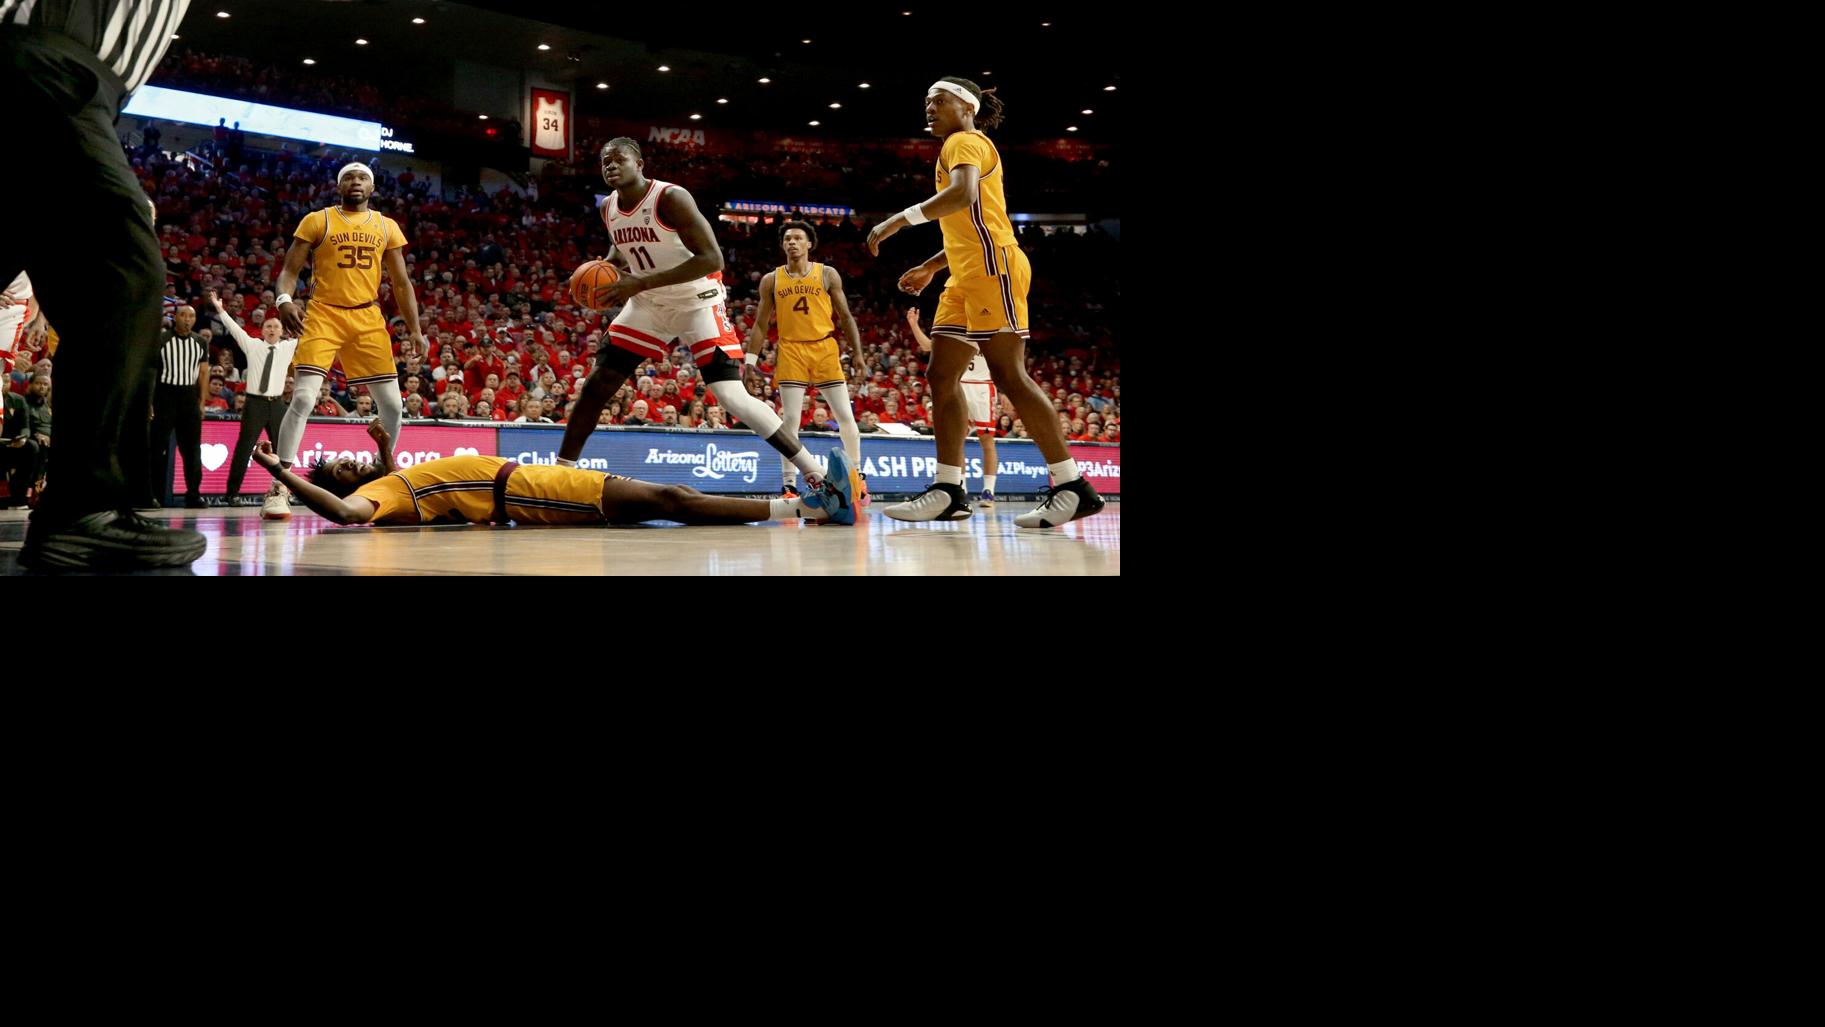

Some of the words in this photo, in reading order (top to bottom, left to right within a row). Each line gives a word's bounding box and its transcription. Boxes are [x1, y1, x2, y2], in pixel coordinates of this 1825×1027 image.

[381, 127, 393, 137] DJ
[543, 118, 558, 131] 34
[648, 126, 705, 146] NCAA
[735, 203, 785, 212] ARIZONA
[330, 232, 350, 246] SUN
[352, 232, 384, 248] DEVILS
[613, 227, 661, 245] ARIZONA
[337, 245, 376, 270] 35
[629, 246, 656, 271] 11
[778, 287, 793, 298] SUN
[794, 285, 821, 296] DEVILS
[793, 296, 809, 315] 4
[645, 449, 705, 465] Arizona
[692, 443, 760, 484] Lottery
[862, 456, 907, 477] ASH
